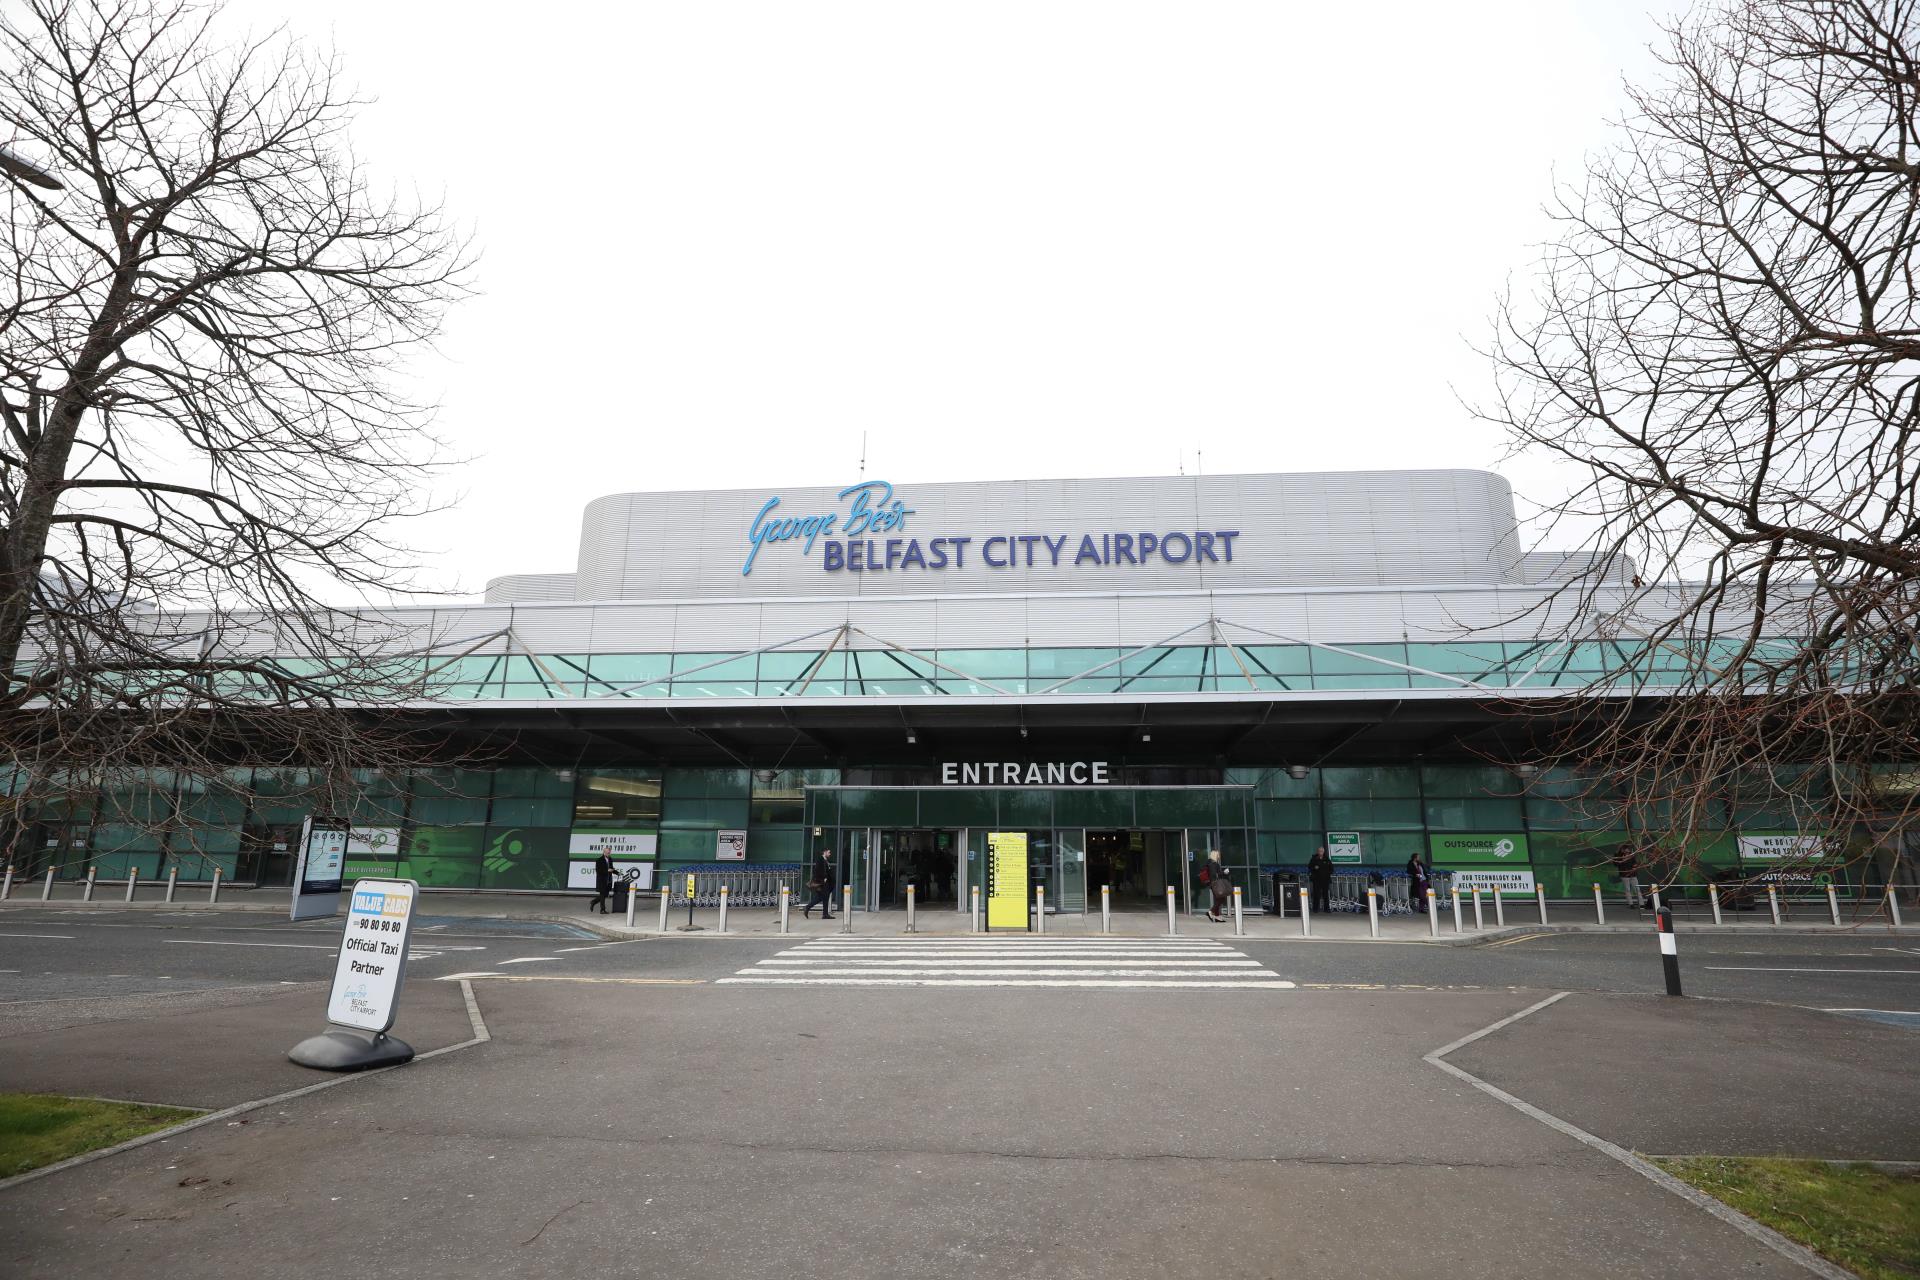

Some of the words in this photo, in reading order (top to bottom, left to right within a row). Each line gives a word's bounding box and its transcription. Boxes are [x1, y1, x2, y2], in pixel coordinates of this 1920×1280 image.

[743, 496, 837, 576] George
[838, 480, 915, 536] Best
[824, 537, 972, 571] BELFAST
[982, 535, 1068, 567] CITY
[1074, 531, 1240, 565] AIRPORT
[942, 761, 1109, 784] ENTRANCE
[354, 894, 383, 912] VALUE
[383, 896, 409, 914] CABS
[360, 918, 369, 929] 90
[370, 919, 380, 930] 80
[381, 920, 390, 932] 90
[391, 921, 401, 933] 80
[346, 938, 378, 952] Official
[380, 942, 399, 956] Taxi
[350, 960, 384, 976] Partner
[350, 1005, 360, 1013] CITY
[359, 1007, 377, 1016] AIRPORT
[352, 998, 368, 1007] BELFAST
